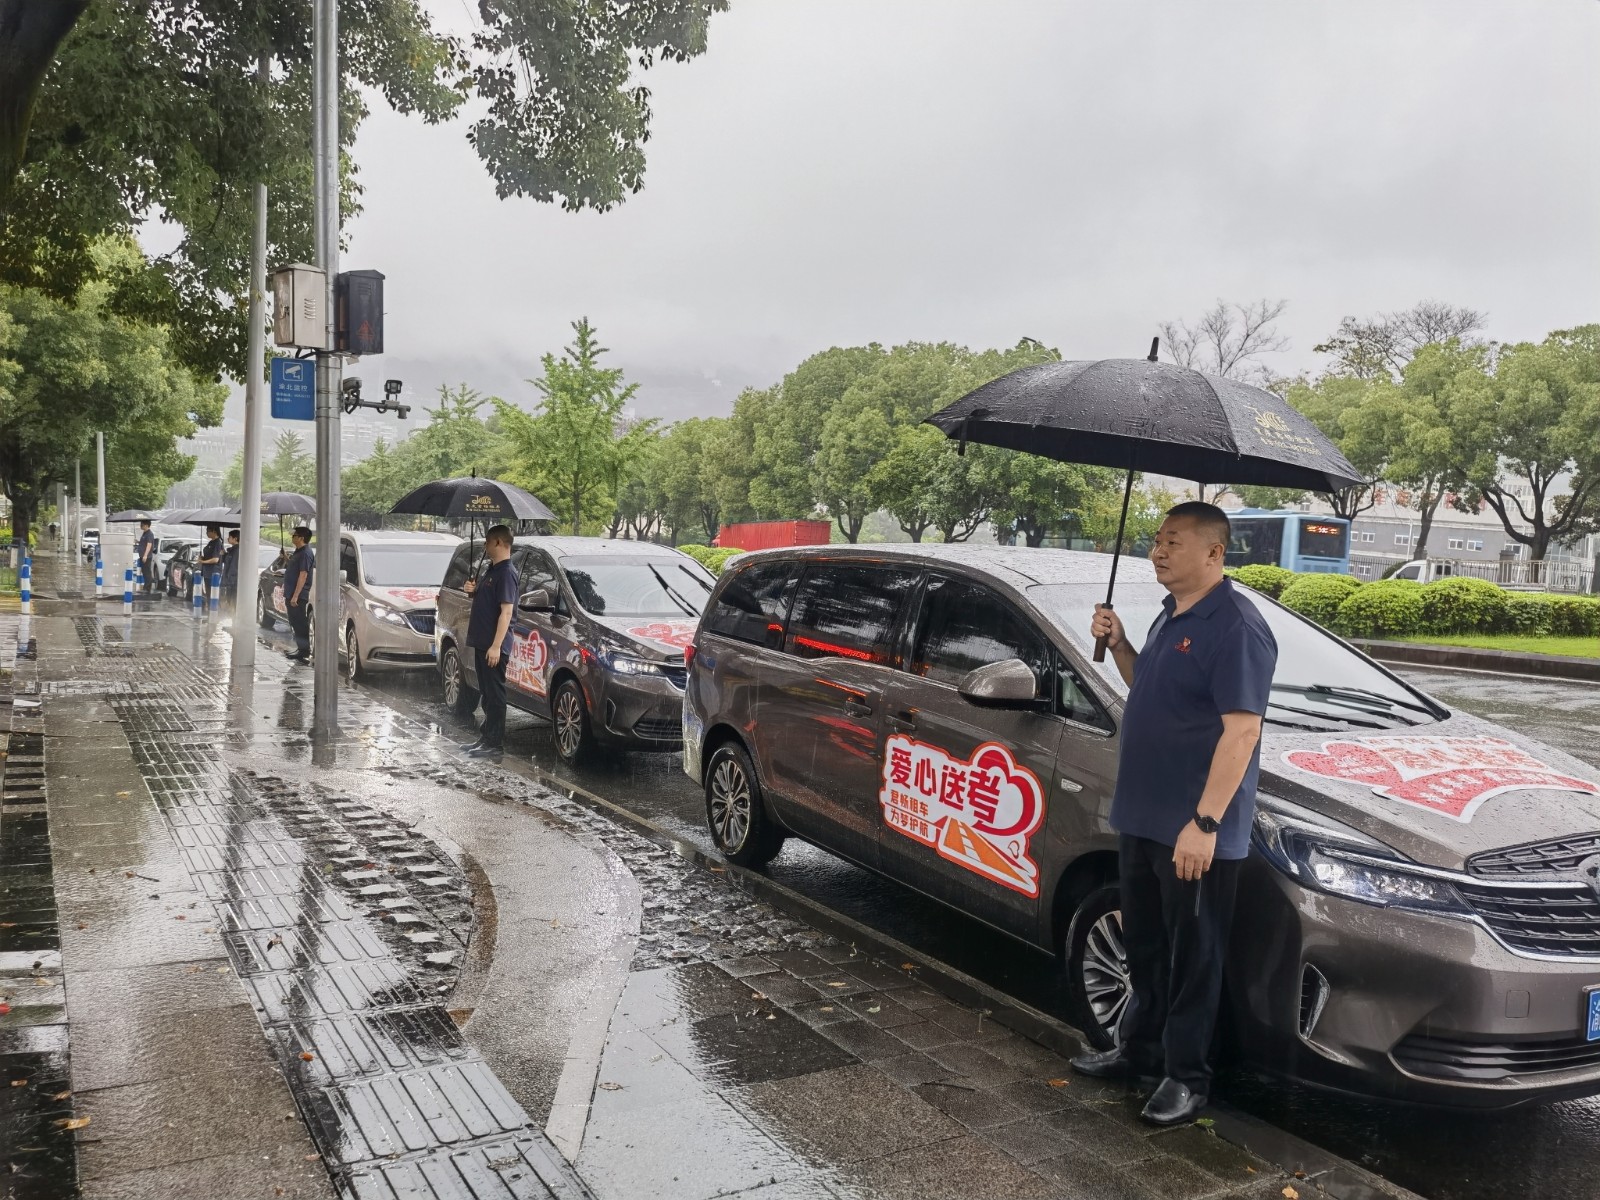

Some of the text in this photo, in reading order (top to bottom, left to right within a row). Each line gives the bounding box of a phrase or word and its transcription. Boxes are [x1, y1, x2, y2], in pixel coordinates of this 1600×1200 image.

[890, 746, 1001, 825] 爱心送考
[890, 790, 929, 816] 君畅租车
[890, 809, 929, 838] 为梦护航
